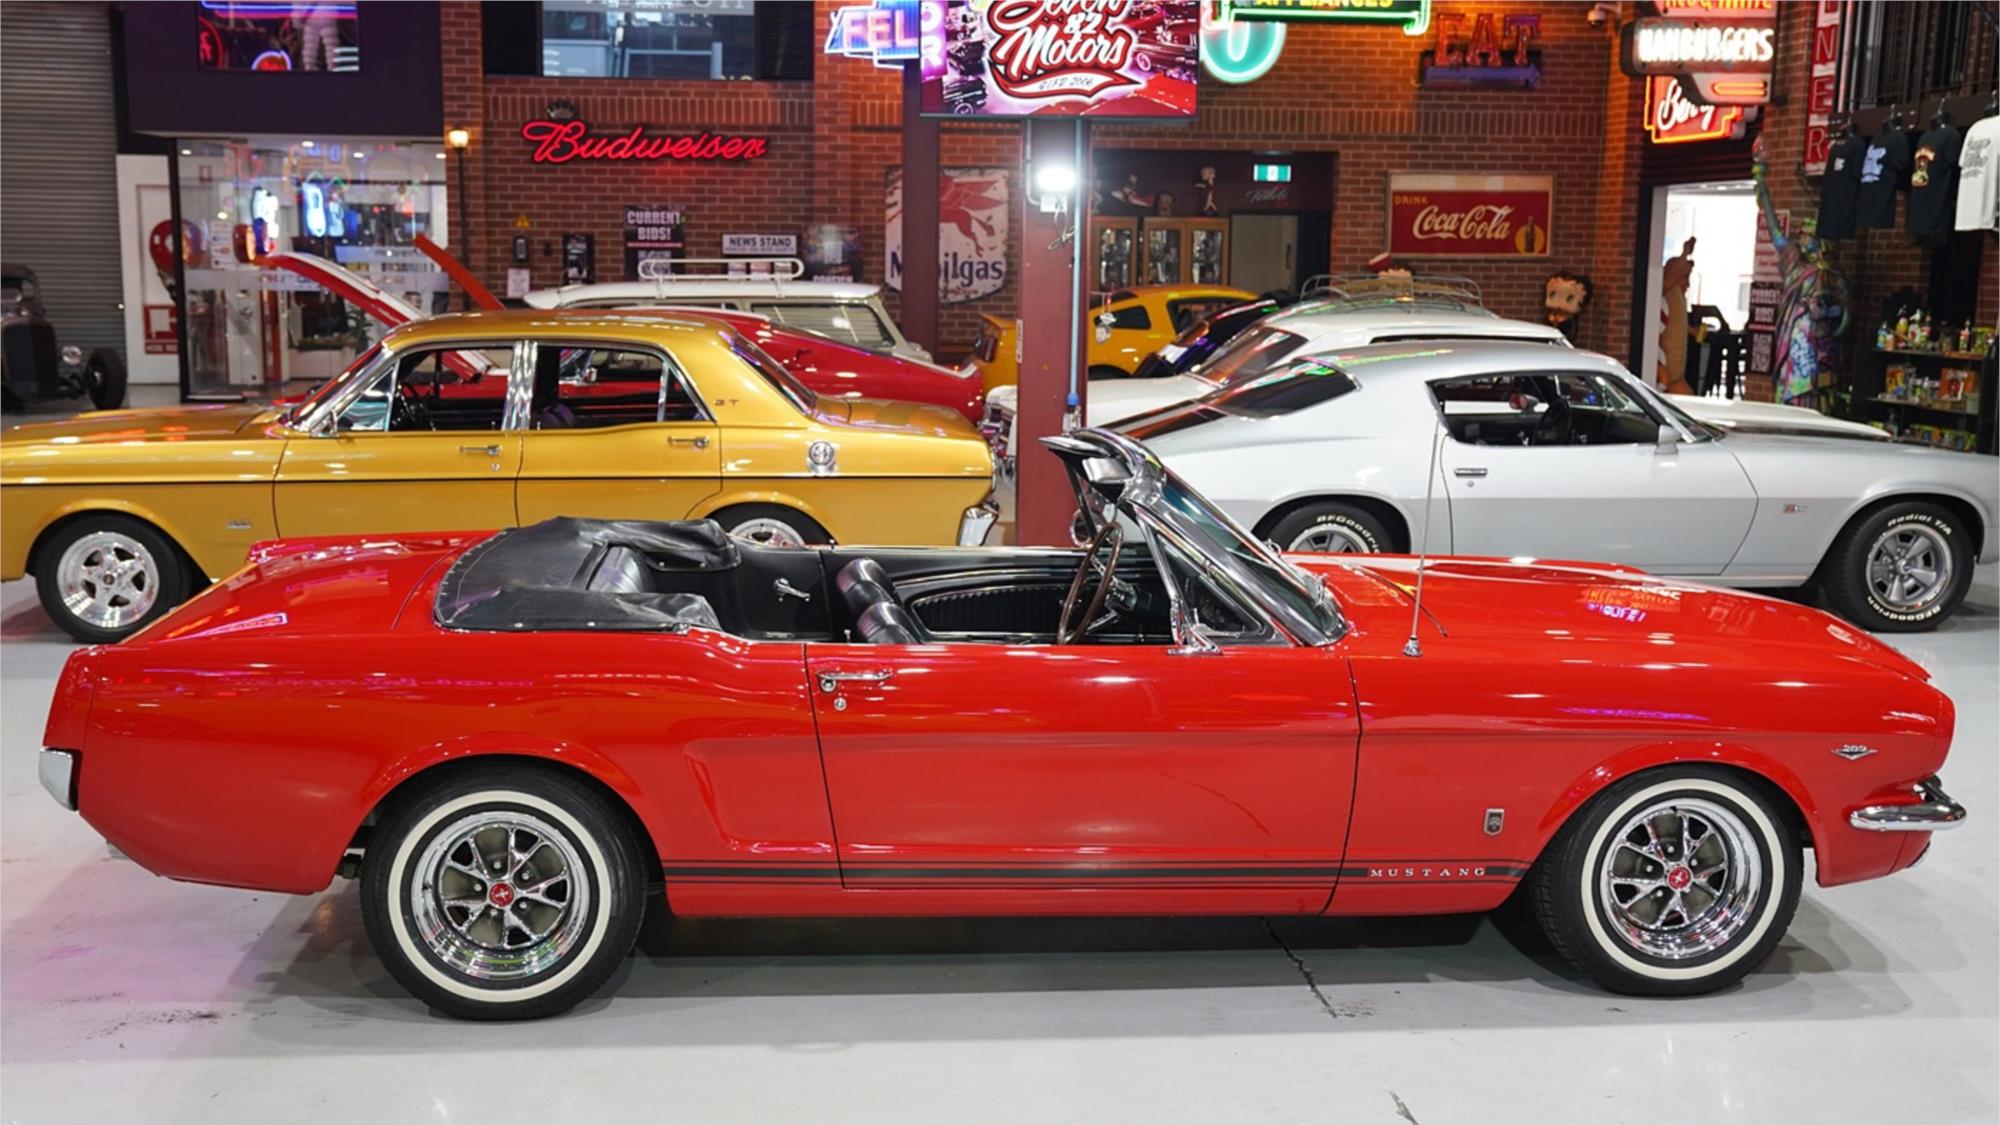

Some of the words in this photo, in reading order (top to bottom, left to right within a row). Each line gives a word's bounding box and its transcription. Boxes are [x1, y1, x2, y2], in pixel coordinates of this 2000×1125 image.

[1064, 12, 1103, 34] 82
[1436, 13, 1541, 66] EAT
[1639, 27, 1774, 61] HAMBURGERS
[996, 24, 1127, 79] Motors
[521, 120, 767, 163] Budweiser
[1394, 196, 1428, 205] DRINK
[627, 211, 680, 225] CURRENT
[1412, 205, 1516, 239] Coca-Cola
[638, 227, 671, 240] BIDS!
[729, 237, 757, 247] NEWS
[760, 237, 792, 247] STAND
[1888, 513, 1932, 527] Radial
[1935, 519, 1952, 535] T/A
[1371, 868, 1485, 877] MUSTANG
